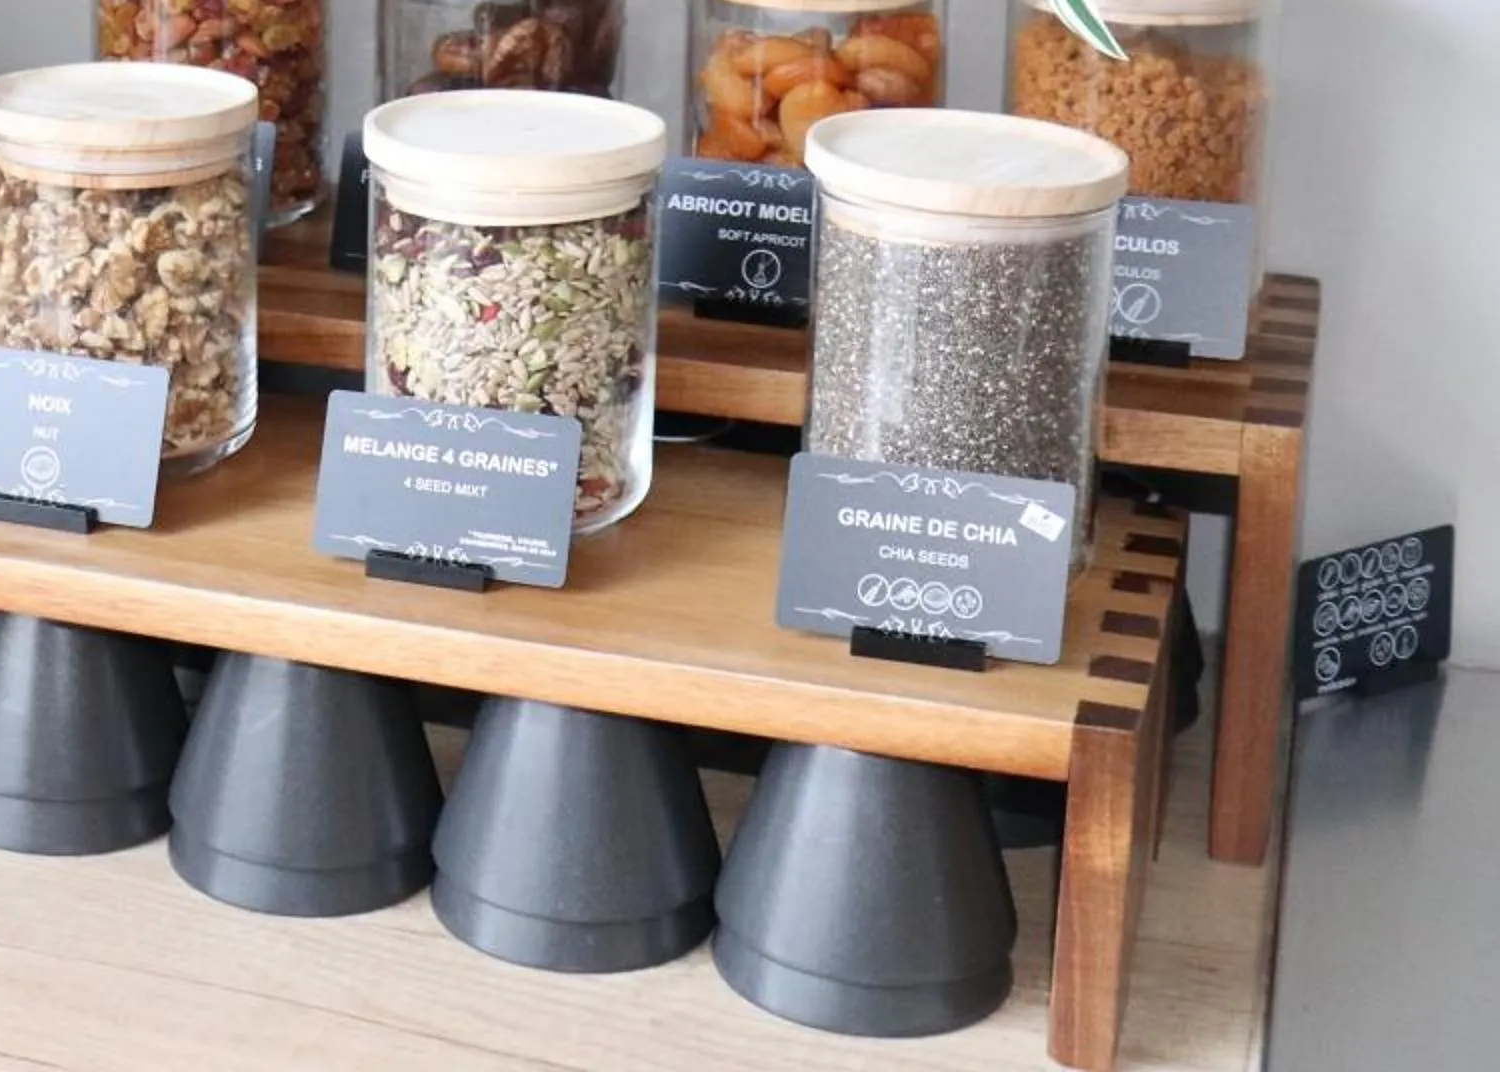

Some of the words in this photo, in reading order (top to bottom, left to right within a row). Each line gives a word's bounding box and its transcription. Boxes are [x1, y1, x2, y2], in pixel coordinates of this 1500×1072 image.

[667, 193, 756, 220] ABRICOT
[758, 203, 812, 225] MOEL
[717, 228, 750, 241] SOFT
[752, 232, 807, 248] APRICOT
[1115, 235, 1180, 256] CULOS
[27, 392, 73, 415] NOIX
[32, 424, 60, 441] NUT
[343, 435, 440, 464] MELANGE
[442, 447, 455, 465] 4
[403, 476, 412, 490] 4
[415, 477, 453, 494] SEED
[454, 481, 490, 499] MIXT
[837, 507, 923, 537] GRAINE
[927, 517, 959, 540] DE
[962, 522, 1018, 547] CHIA
[879, 545, 915, 562] CHIA
[917, 548, 971, 570] SEEDS
